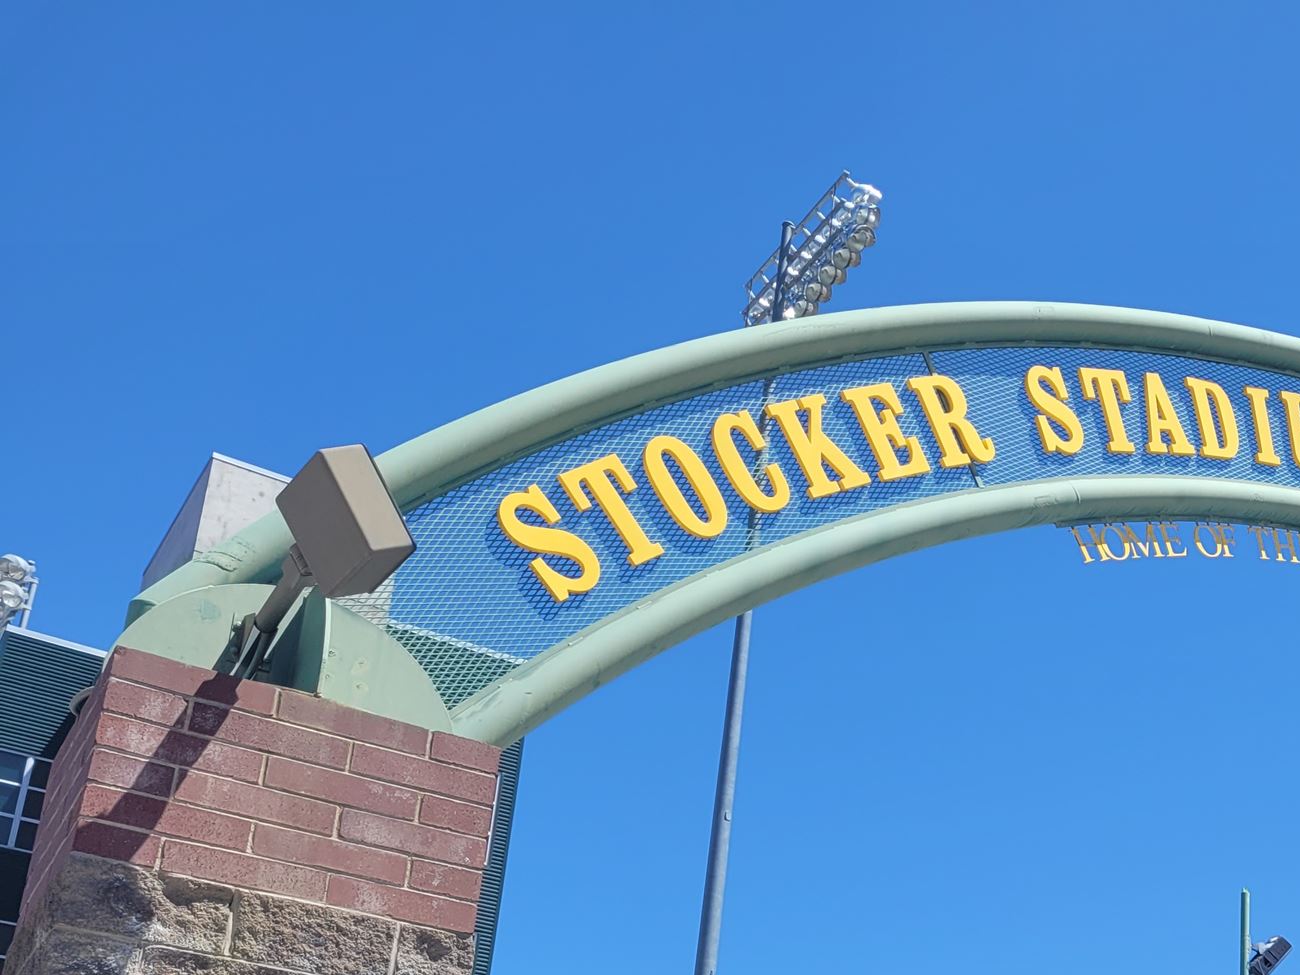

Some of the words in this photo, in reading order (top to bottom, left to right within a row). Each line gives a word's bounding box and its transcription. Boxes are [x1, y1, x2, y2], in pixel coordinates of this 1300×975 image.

[498, 375, 995, 602] STOCKER
[1071, 523, 1187, 564] HOME
[1194, 523, 1235, 558] OF
